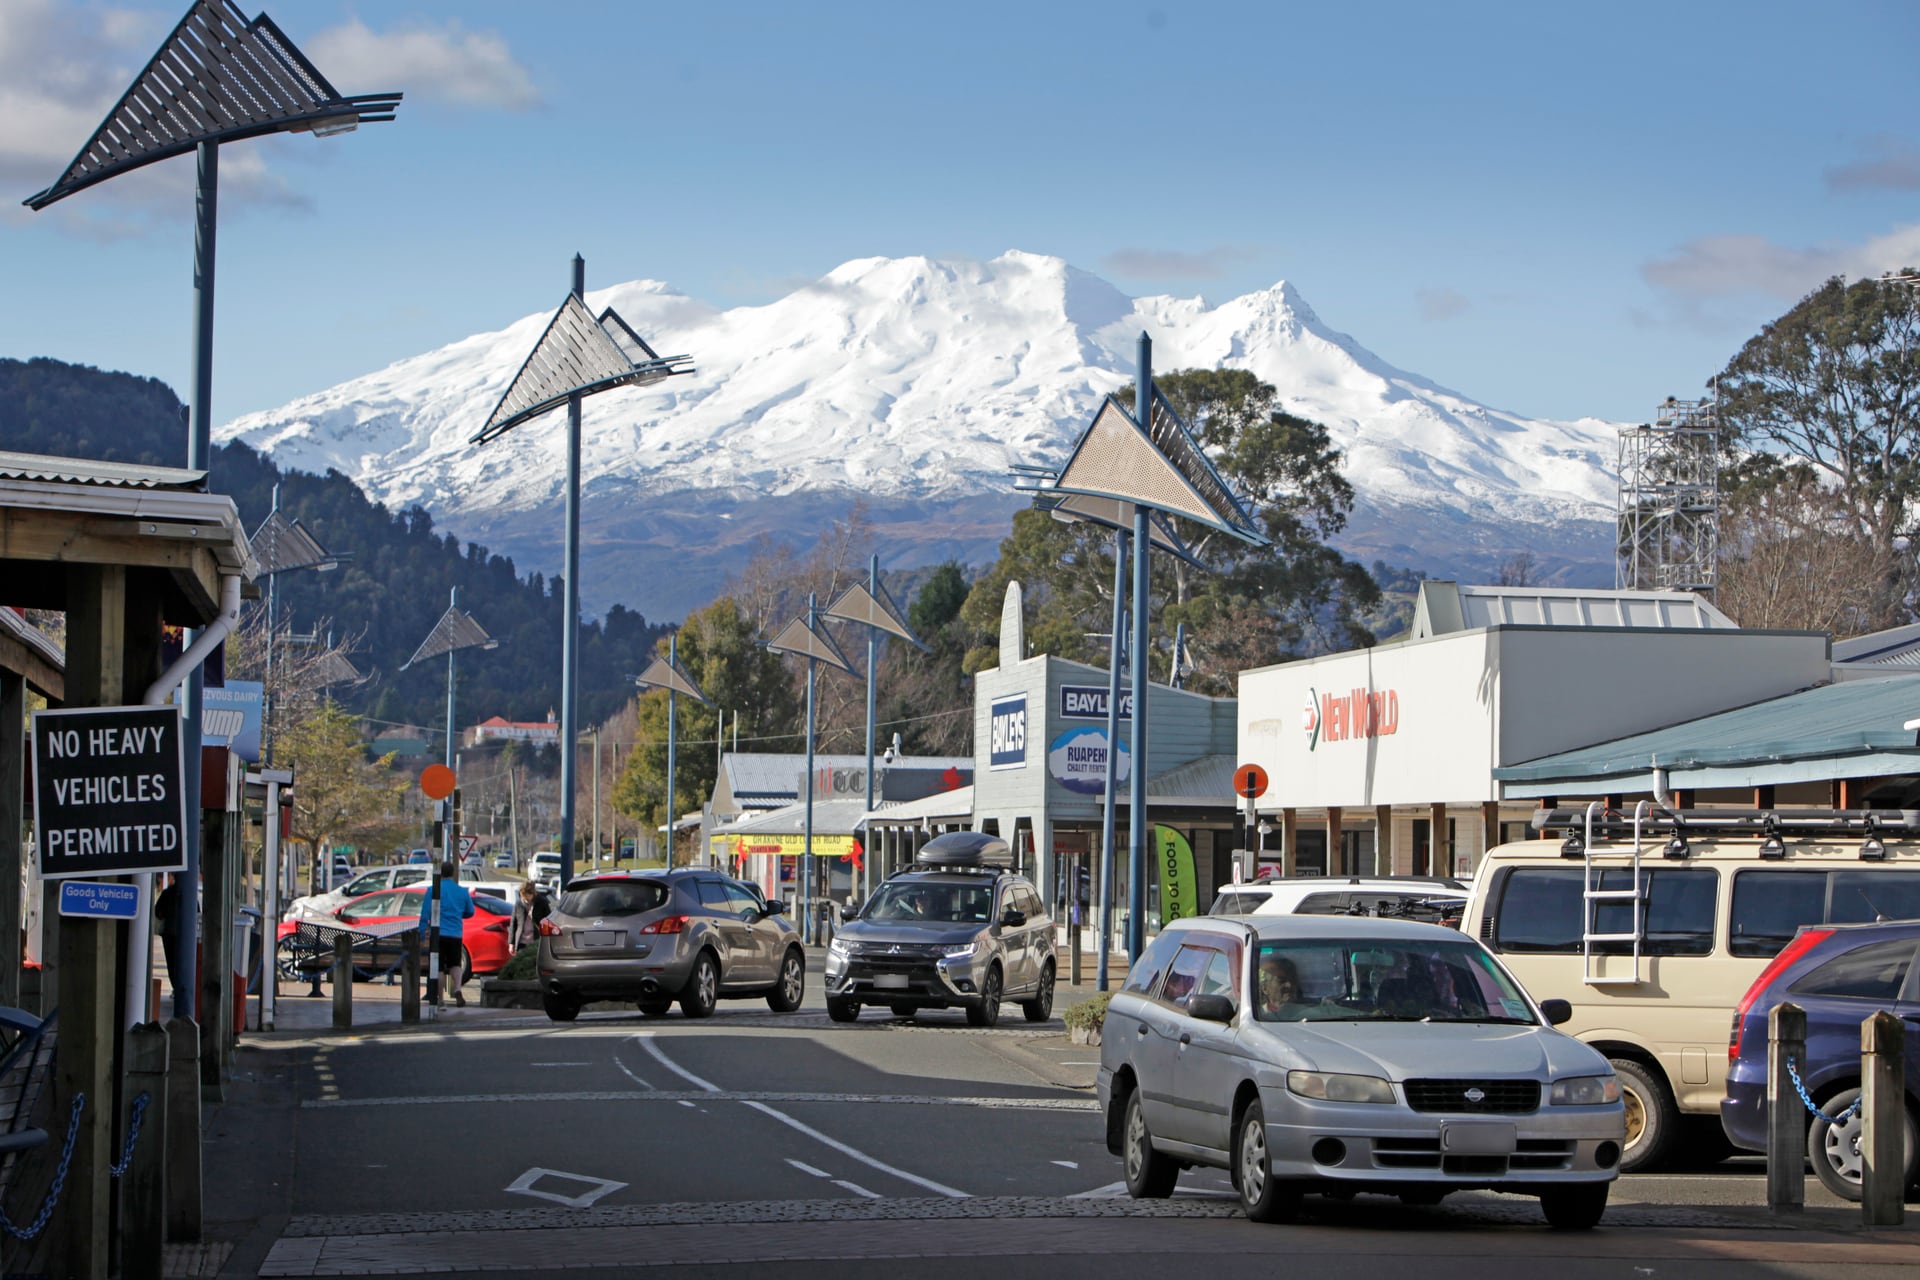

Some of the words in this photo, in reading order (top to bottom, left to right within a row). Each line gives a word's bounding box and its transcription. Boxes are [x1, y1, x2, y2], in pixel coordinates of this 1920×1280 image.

[234, 691, 259, 702] DAIRY
[1066, 692, 1132, 714] BAYLYS
[1322, 692, 1350, 742] NEW
[1351, 687, 1399, 739] WORLD
[992, 710, 1025, 754] BAYLEYS
[49, 730, 80, 759] NO
[89, 726, 165, 756] HEAVY
[1067, 763, 1088, 773] CHALET
[53, 774, 166, 806] VEHICLES
[48, 824, 177, 857] PERMITTED
[753, 834, 783, 845] OHAKUNE
[785, 834, 797, 845] OLD
[823, 834, 841, 845] ROAD
[1166, 842, 1178, 878] FOOD
[66, 886, 96, 897] Goods
[98, 887, 134, 899] Vehicles
[1168, 881, 1179, 898] TO
[89, 898, 109, 911] Only
[1170, 902, 1180, 920] GO
